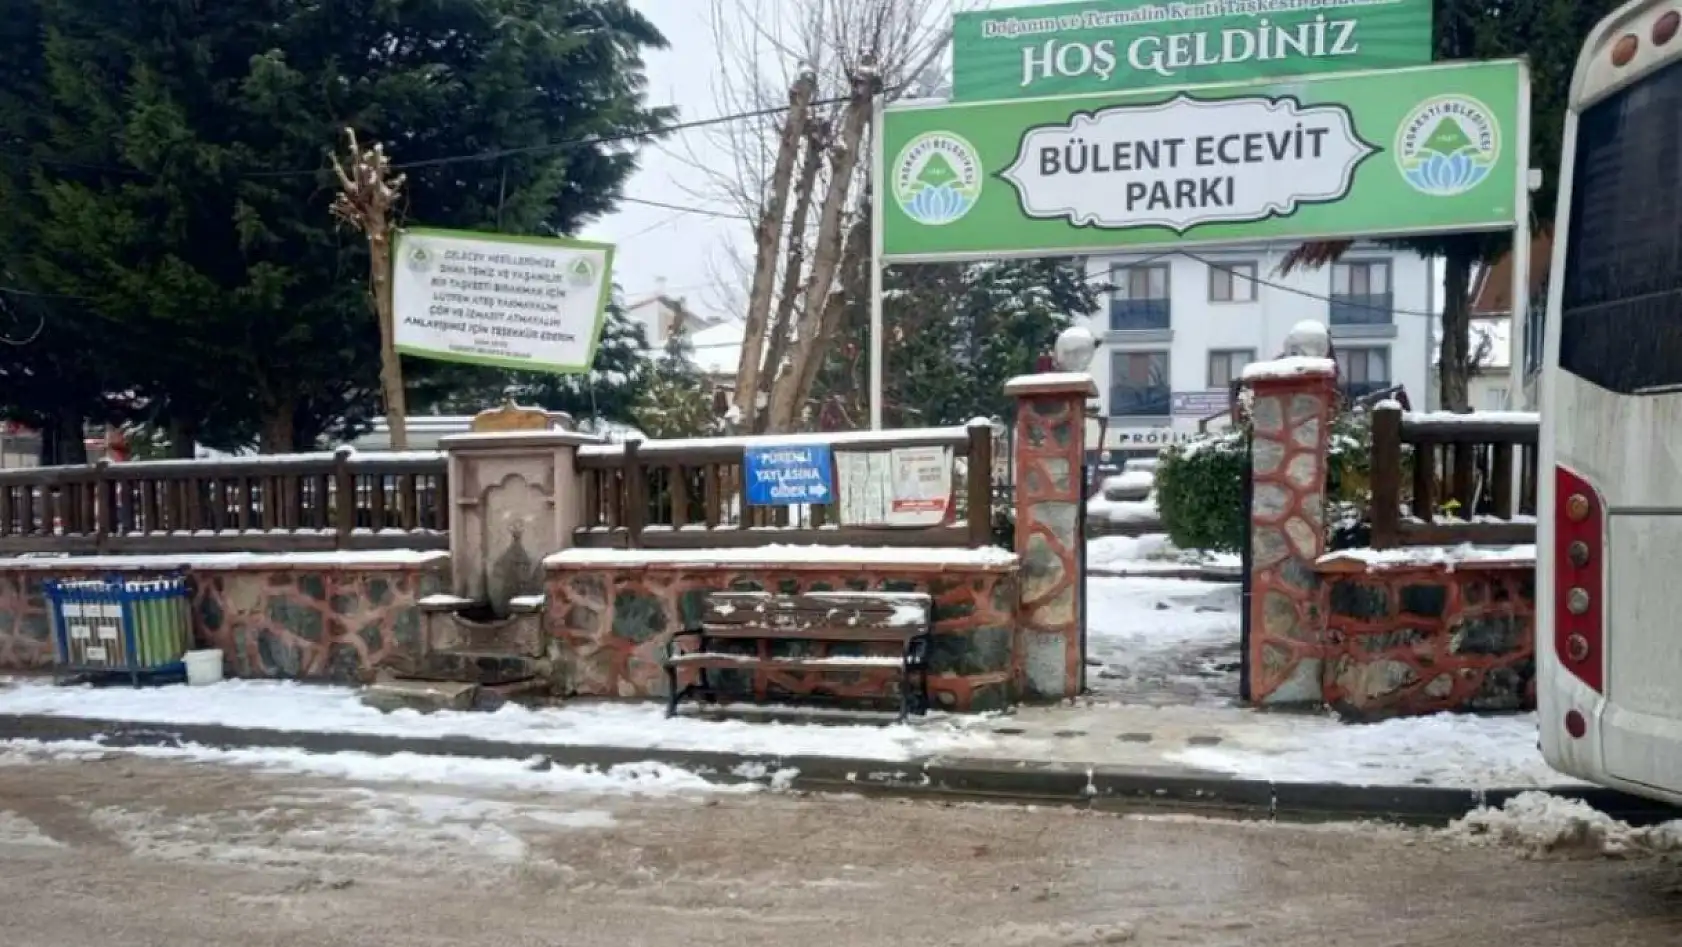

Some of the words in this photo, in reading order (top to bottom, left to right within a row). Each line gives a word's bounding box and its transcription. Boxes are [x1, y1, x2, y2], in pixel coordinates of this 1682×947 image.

[1058, 14, 1081, 29] ve
[1084, 6, 1167, 28] Termalin
[1021, 39, 1116, 86] HOŞ
[1128, 13, 1359, 77] GELDİNİZ
[1039, 137, 1182, 176] BÜLENT
[1196, 126, 1331, 168] ECEVİT
[1125, 175, 1237, 211] PARKI
